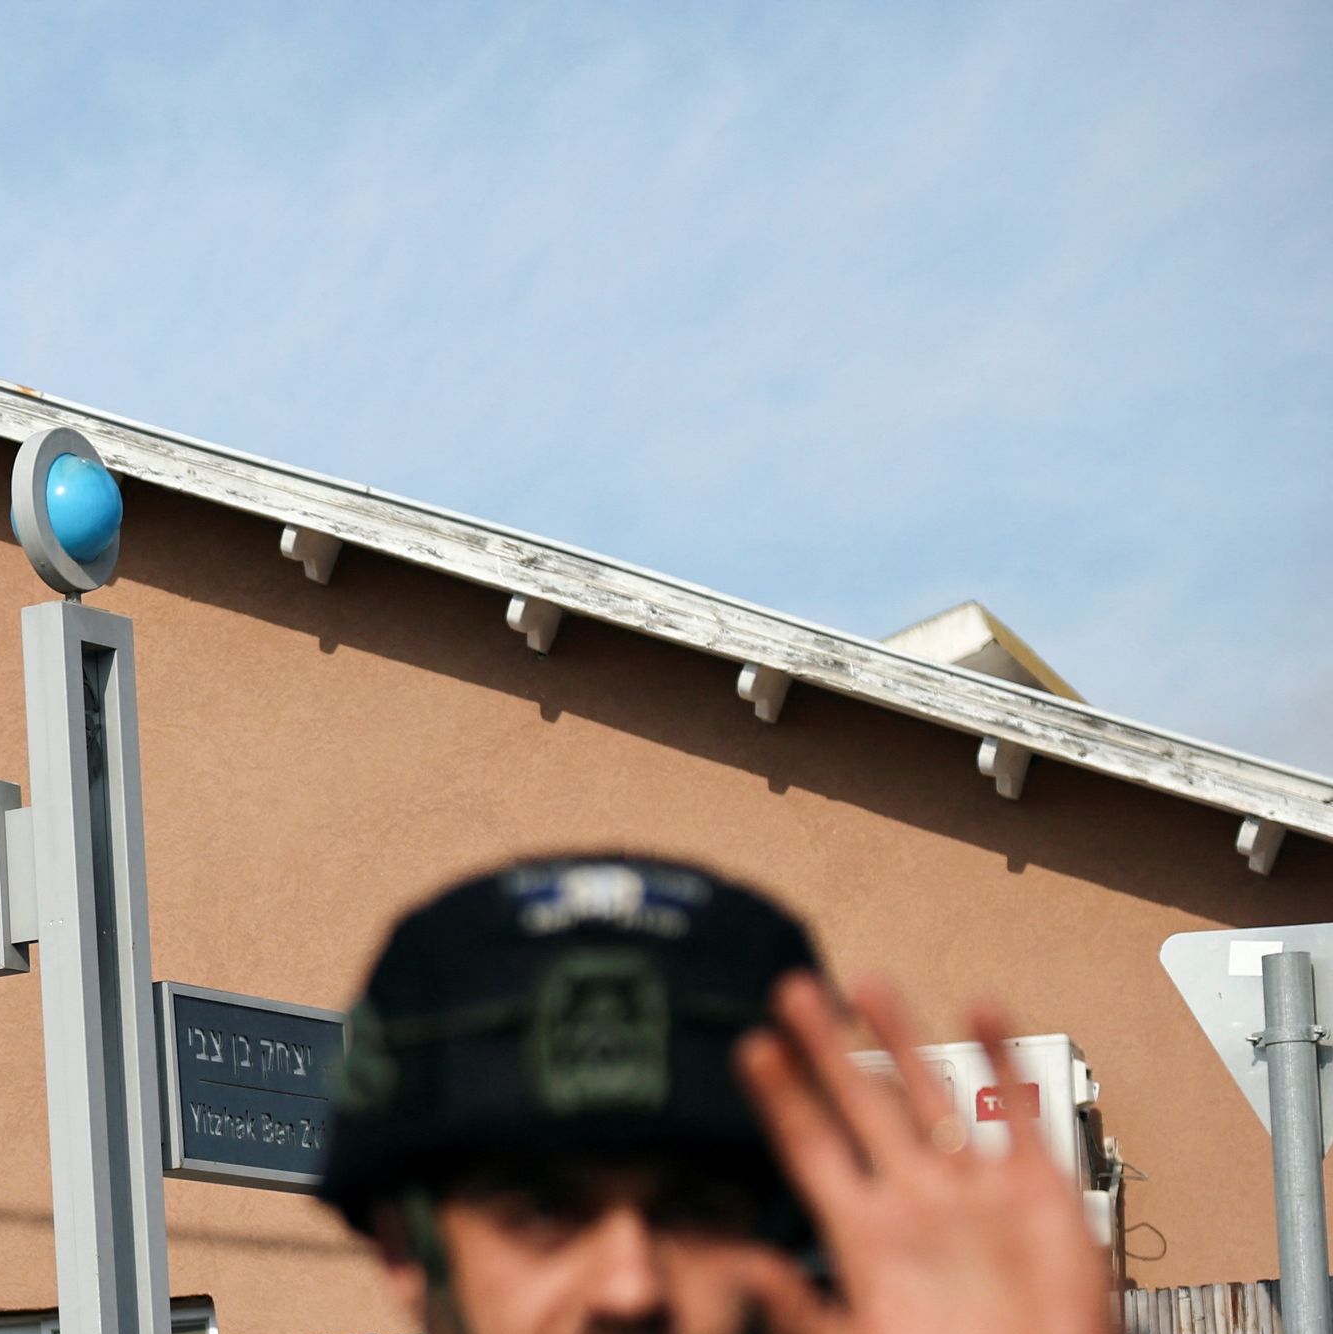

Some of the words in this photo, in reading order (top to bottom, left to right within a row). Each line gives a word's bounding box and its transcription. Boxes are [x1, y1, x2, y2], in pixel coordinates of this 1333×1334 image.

[188, 1025, 224, 1063] צבי
[232, 1032, 253, 1077] בן
[260, 1038, 313, 1081] יצחק
[190, 1101, 257, 1141] Yitzhak
[260, 1111, 296, 1146] Ben
